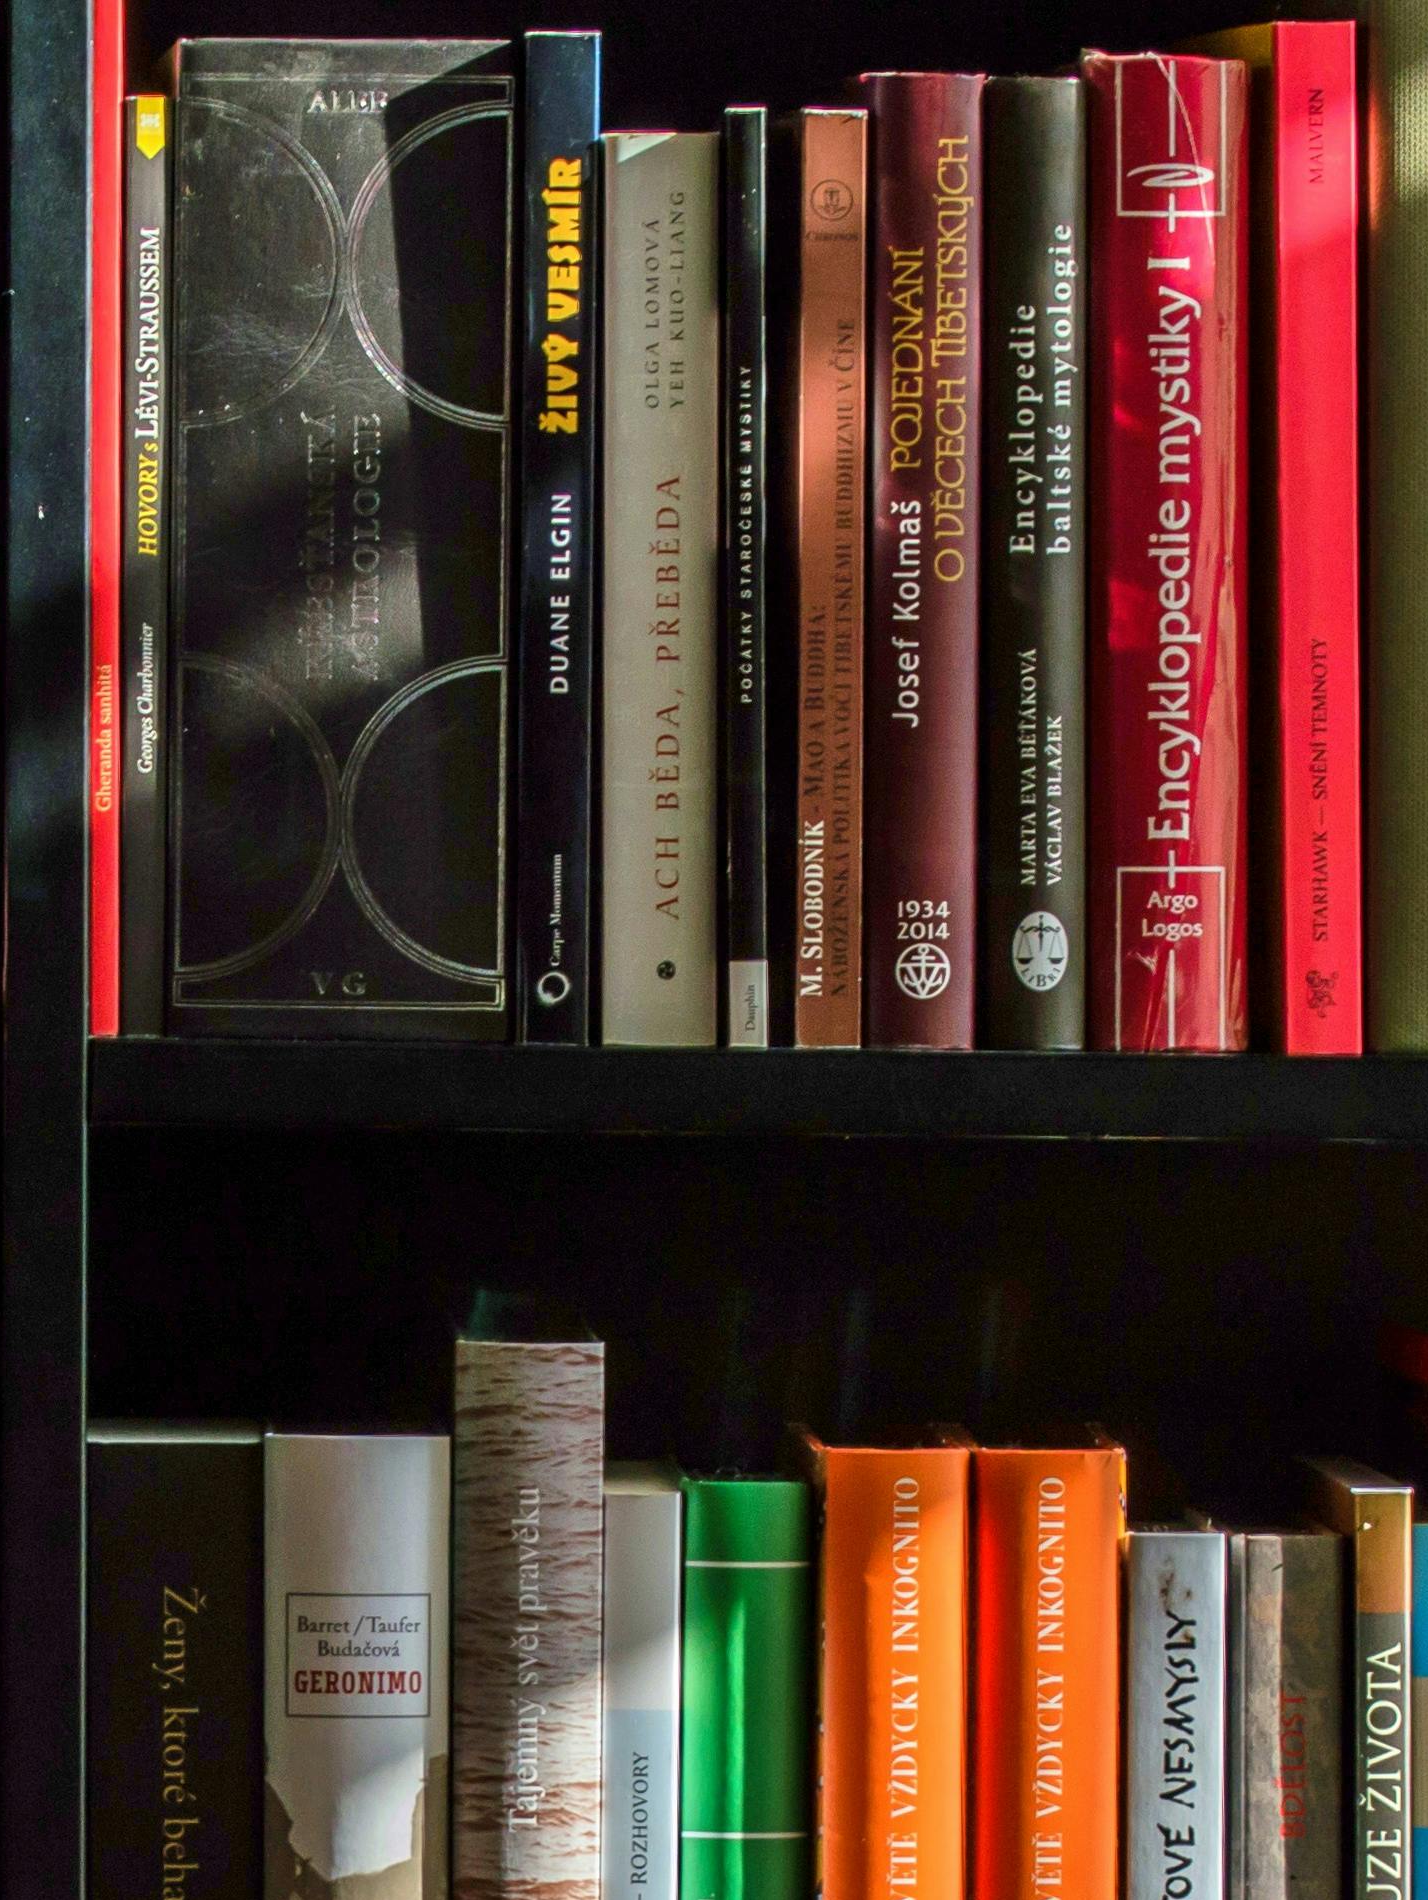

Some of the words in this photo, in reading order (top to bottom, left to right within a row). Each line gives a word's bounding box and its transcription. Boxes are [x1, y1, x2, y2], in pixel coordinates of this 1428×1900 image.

[538, 157, 582, 318] VESMÍR
[1147, 255, 1189, 271] I
[538, 334, 580, 433] ŽIVÝ
[1046, 222, 1078, 407] mytologie
[1147, 284, 1202, 483] mystiky
[1008, 303, 1039, 554] Encyklopedie
[1045, 422, 1074, 554] baltské
[549, 493, 571, 579] ELGIN
[891, 498, 922, 622] Kolmaš
[549, 591, 571, 693] DUANE
[891, 637, 923, 727] Josef
[1147, 497, 1202, 839] Encyklopedie
[891, 1475, 921, 1652] INKOGNITO
[293, 1668, 422, 1694] GERONIMO
[885, 1667, 920, 1817] VŽDYCKY
[1356, 1641, 1404, 1814] ŽIVOTA
